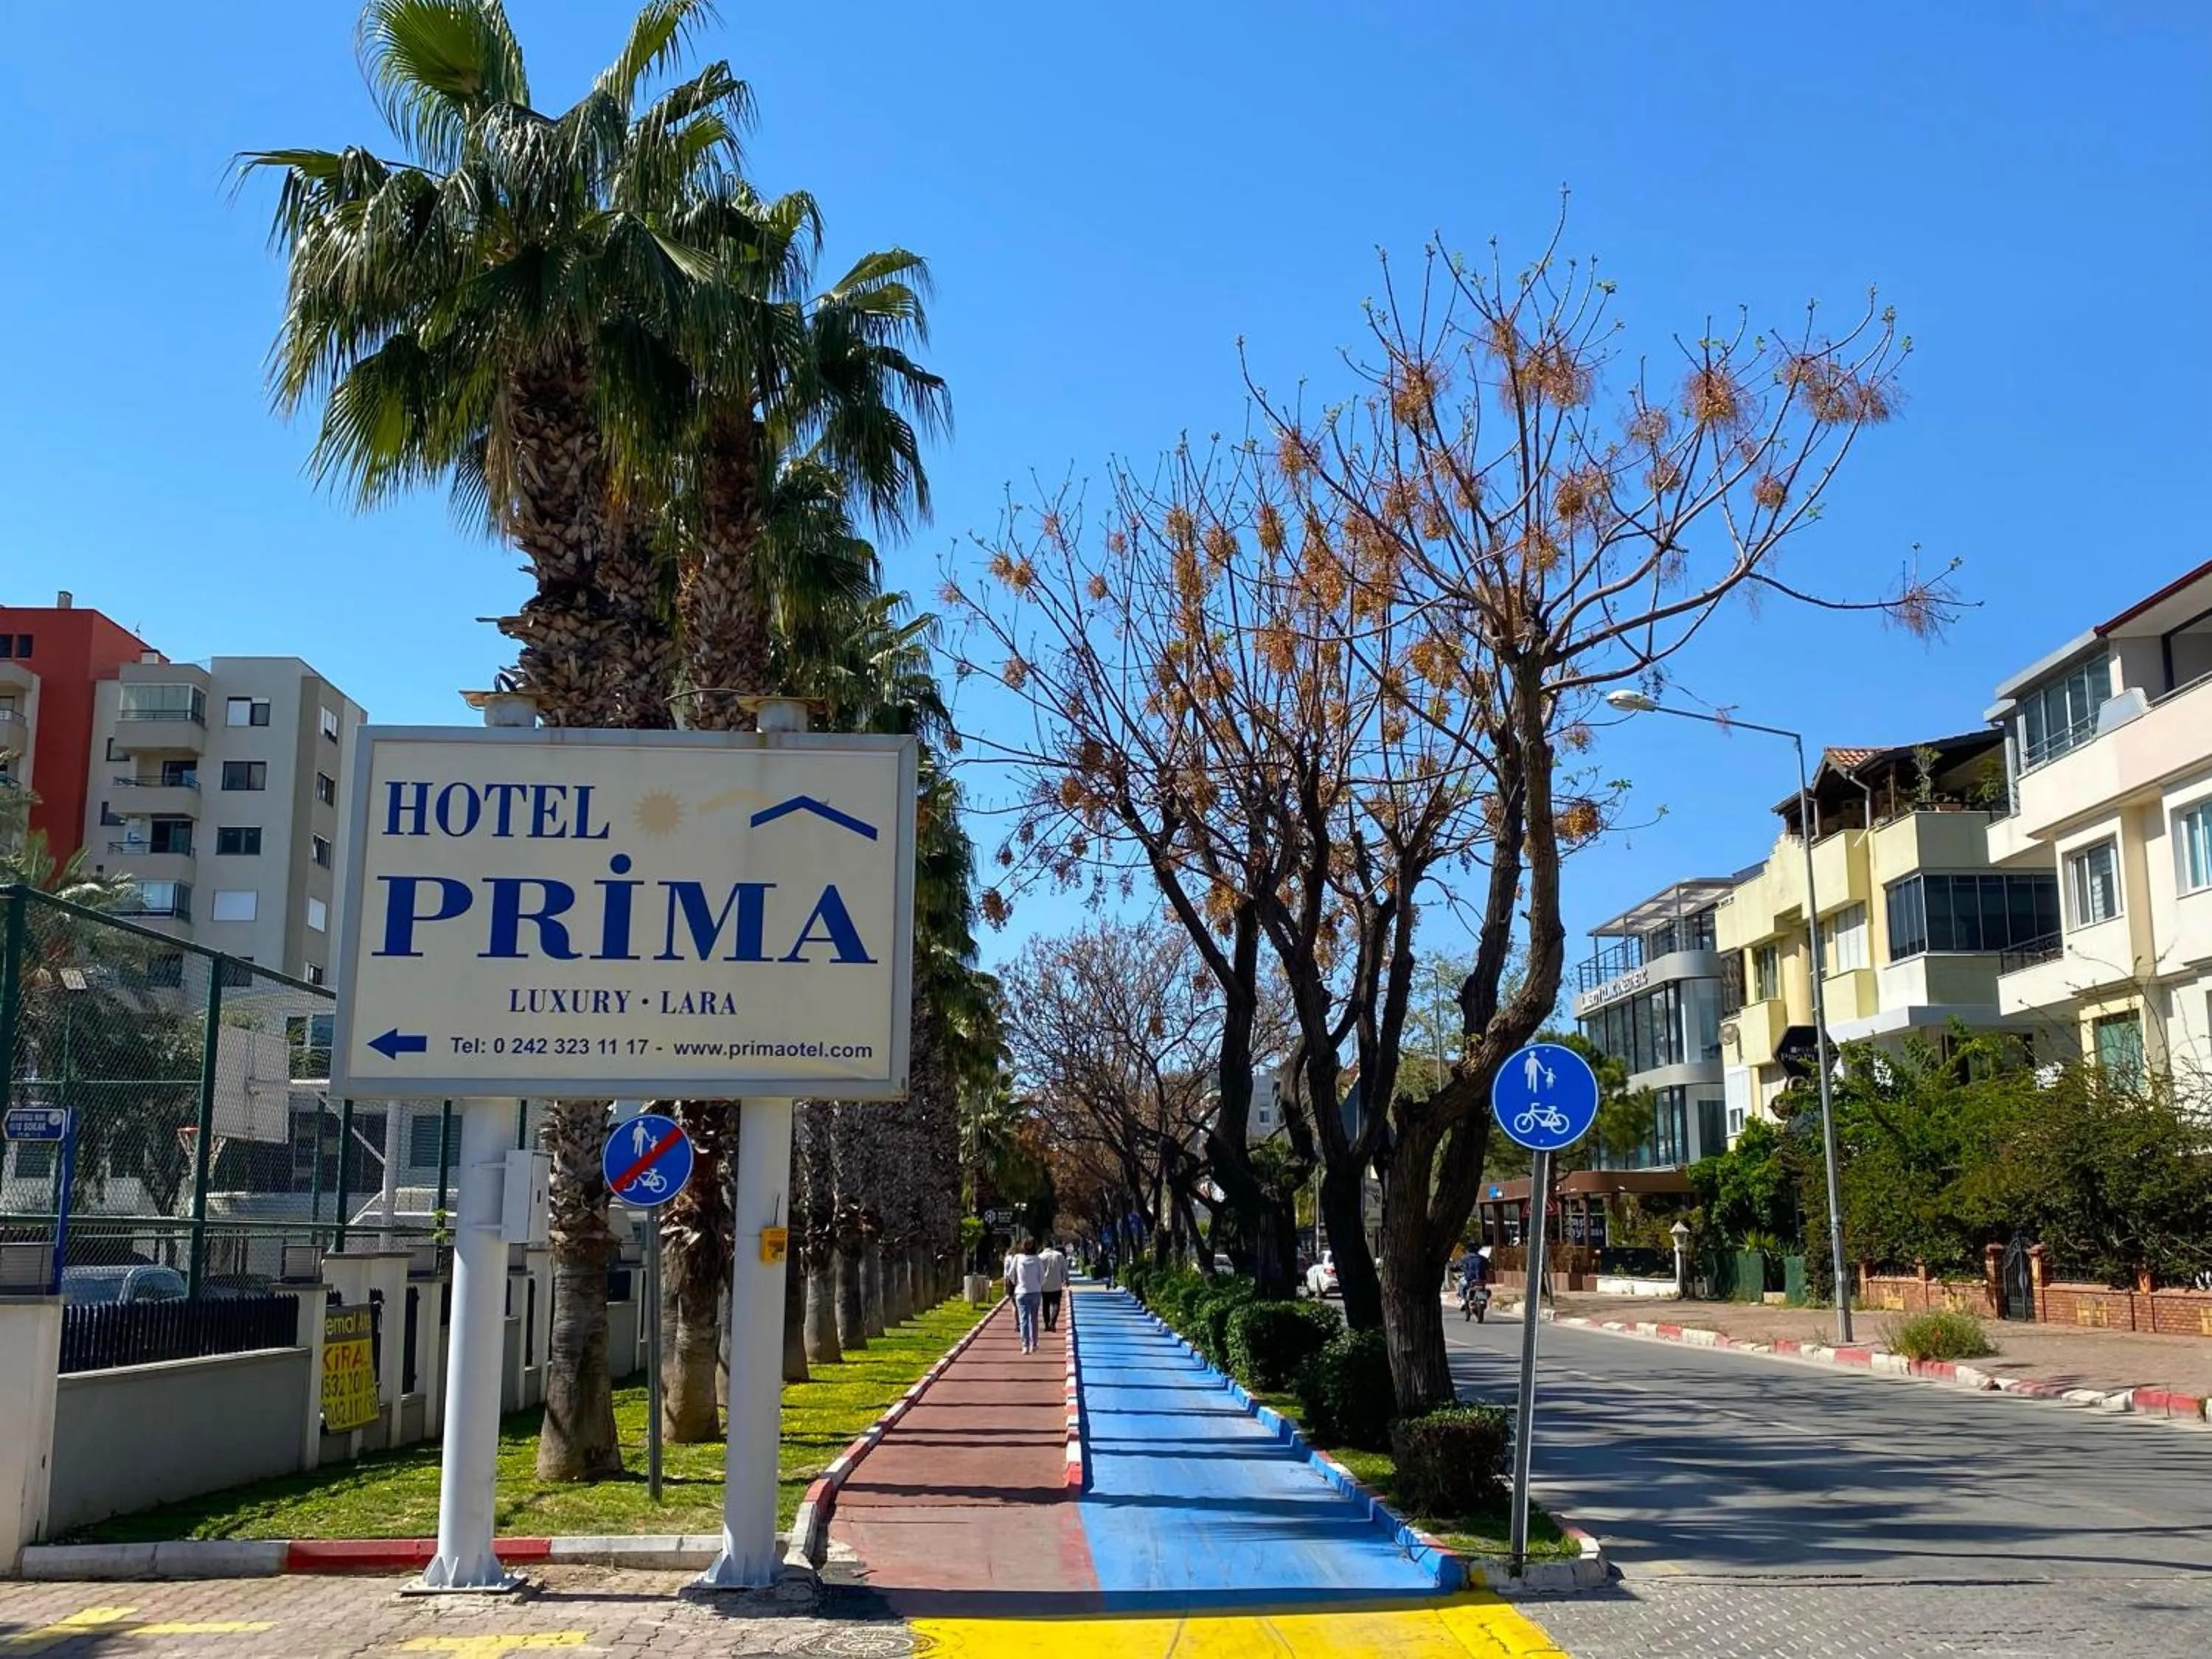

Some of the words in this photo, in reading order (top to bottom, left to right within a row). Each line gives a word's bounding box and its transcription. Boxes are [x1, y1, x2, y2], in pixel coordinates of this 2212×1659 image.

[381, 781, 611, 840] HOTEL
[509, 989, 631, 1014] LUXURY
[661, 990, 737, 1015] LARA
[451, 1037, 487, 1054] Tel:
[493, 1037, 505, 1054] 0
[511, 1037, 548, 1054] 242
[554, 1038, 590, 1054] 323
[597, 1039, 618, 1055] 11
[626, 1039, 650, 1055] 17
[673, 1040, 873, 1060] www.primaotel.com
